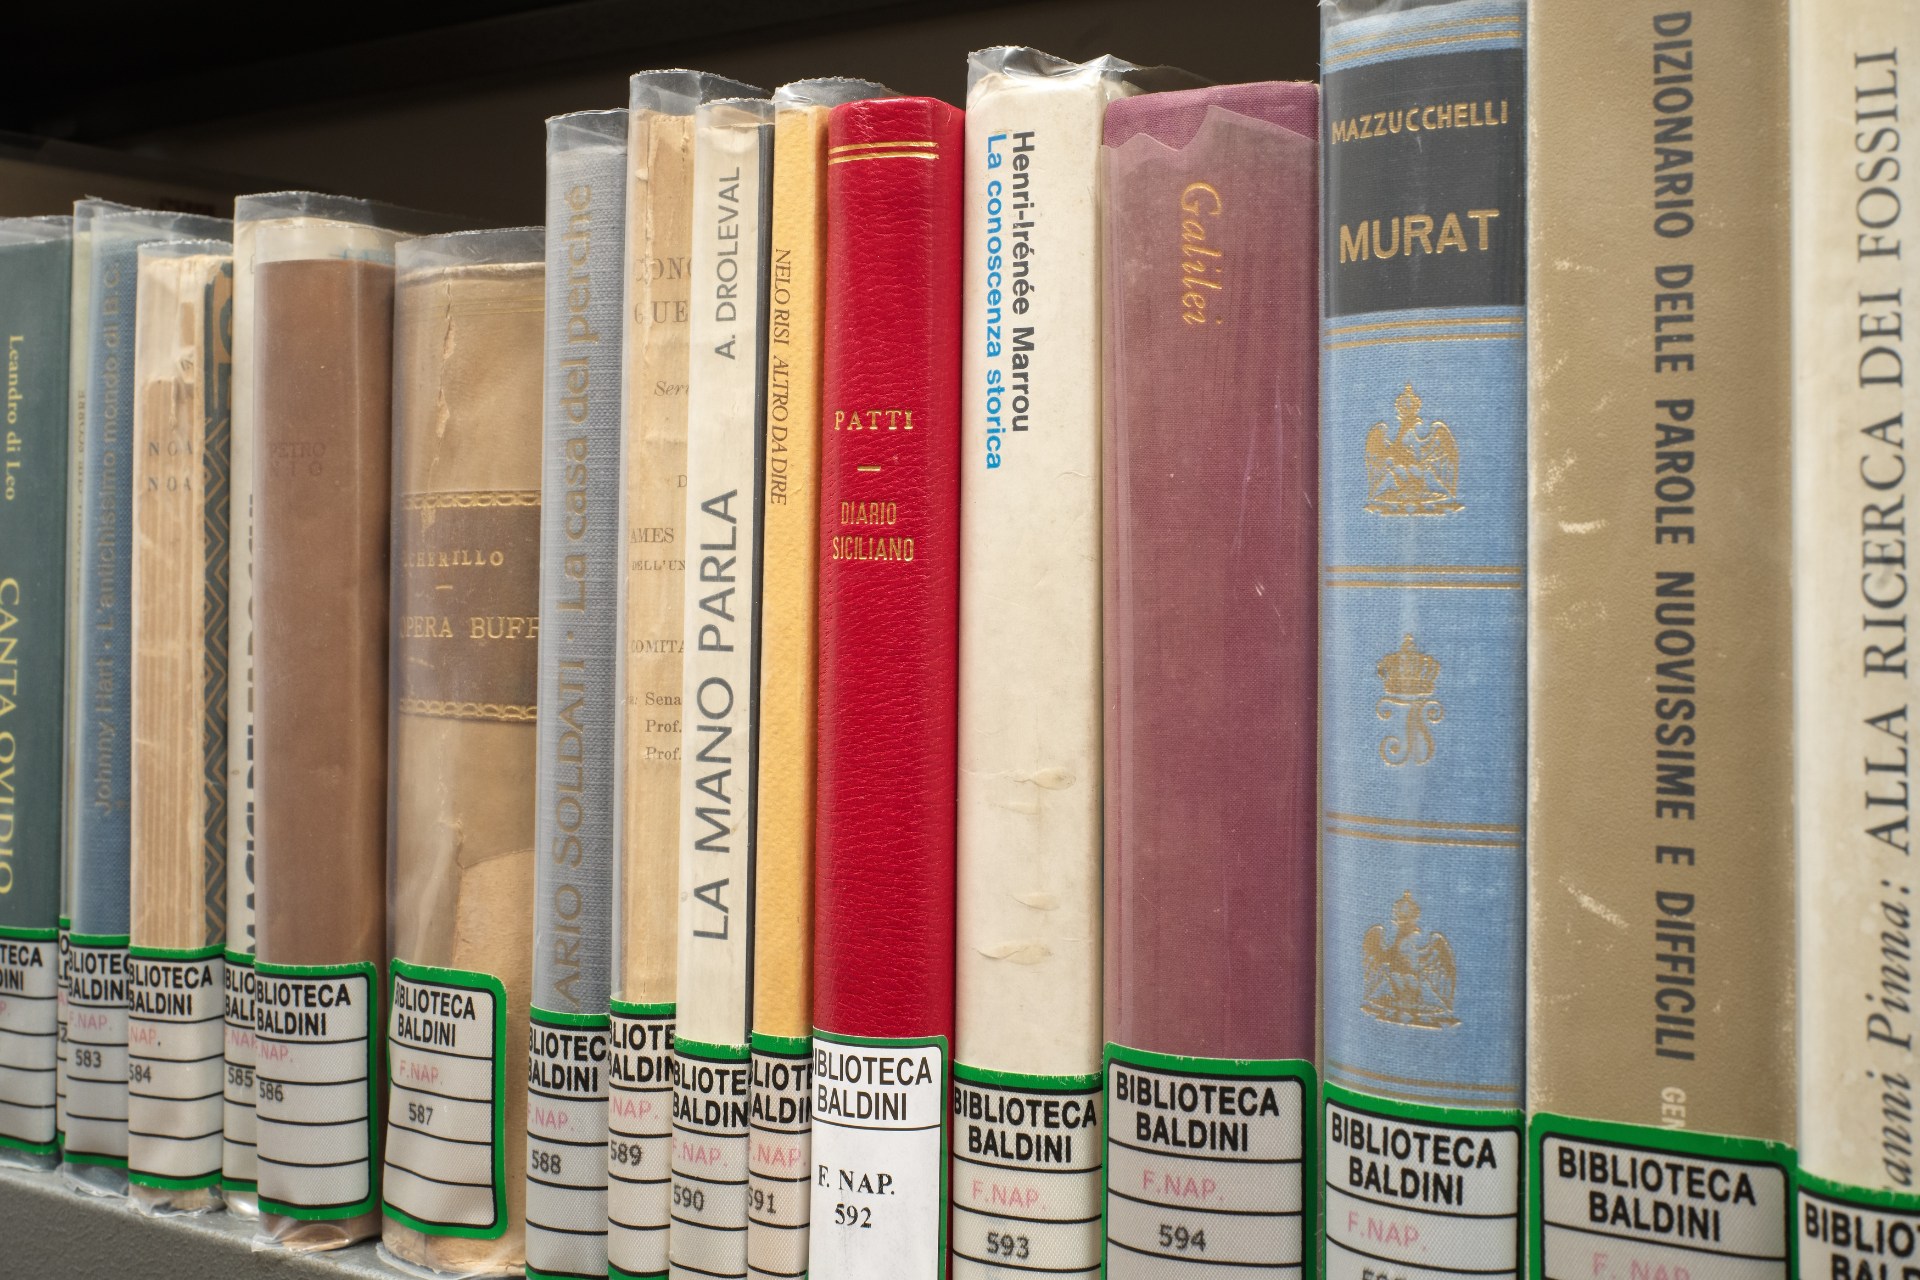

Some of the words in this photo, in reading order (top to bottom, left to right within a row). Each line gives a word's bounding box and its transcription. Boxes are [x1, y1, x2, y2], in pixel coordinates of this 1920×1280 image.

[1331, 100, 1508, 144] MAZZUCCHELLI
[1652, 11, 1694, 239] DIZIONARIO
[987, 134, 1007, 170] La
[1854, 46, 1902, 263] FOSSILI
[716, 167, 740, 328] DROLEVAL
[1012, 131, 1035, 315] Henri-Irénée
[1339, 209, 1500, 264] MURAT
[561, 183, 599, 344] perché
[774, 249, 791, 304] NELO
[986, 180, 1003, 358] conoscenza
[1181, 182, 1223, 325] Galilei
[774, 309, 790, 345] RISI
[1653, 264, 1694, 374] DELLE
[1857, 288, 1904, 389] DEI
[715, 334, 736, 360] A.
[7, 335, 24, 425] Leandro
[560, 356, 590, 424] del
[772, 356, 789, 422] ALTRO
[1012, 326, 1035, 432] Marrou
[6, 430, 22, 455] di
[771, 427, 788, 453] DA
[834, 410, 914, 431] PATTI
[986, 368, 1006, 470] storica
[5, 461, 20, 500] Leo
[565, 435, 588, 542] casa
[771, 458, 787, 506] DIRE
[1654, 398, 1695, 545] PAROLE
[841, 501, 897, 526] DIARIO
[699, 488, 738, 652] PARLA
[832, 535, 915, 562] SICILIANO
[1859, 412, 1908, 679] RICERCA
[556, 553, 587, 612] La
[96, 657, 115, 712] Hart
[1655, 572, 1695, 820] NUOVISSIME
[94, 724, 116, 817] Johnny
[552, 658, 585, 871] SOLDATI
[695, 677, 734, 854] MANO
[1864, 704, 1910, 855] ALLA
[1656, 845, 1695, 866] E
[693, 878, 730, 940] LA
[1655, 890, 1695, 1061] DIFFICILI
[1866, 880, 1911, 1050] Pinna:
[257, 1007, 327, 1036] BALDINI
[398, 1013, 456, 1047] BALDINI
[75, 1048, 102, 1068] 583
[228, 1067, 254, 1088] 585
[259, 1082, 284, 1103] 586
[409, 1102, 434, 1125] 587
[817, 1084, 907, 1121] BALDINI
[954, 1088, 1097, 1128] BIBLIOTECA
[1117, 1071, 1280, 1117] BIBLIOTECA
[611, 1139, 642, 1167] 589
[969, 1126, 1072, 1163] BALDINI
[1136, 1112, 1249, 1152] BALDINI
[1332, 1112, 1497, 1170] BIBLIOTECA
[1866, 1070, 1912, 1189] anni
[532, 1149, 561, 1175] 588
[839, 1169, 895, 1195] NAP.
[1349, 1157, 1464, 1206] BALDINI
[1558, 1146, 1757, 1206] BIBLIOTECA
[673, 1183, 704, 1212] 590
[834, 1204, 872, 1229] 592
[1588, 1191, 1720, 1242] BALDINI
[987, 1232, 1030, 1259] 593
[1158, 1224, 1207, 1252] 594
[1804, 1204, 1920, 1262] BIBLIO
